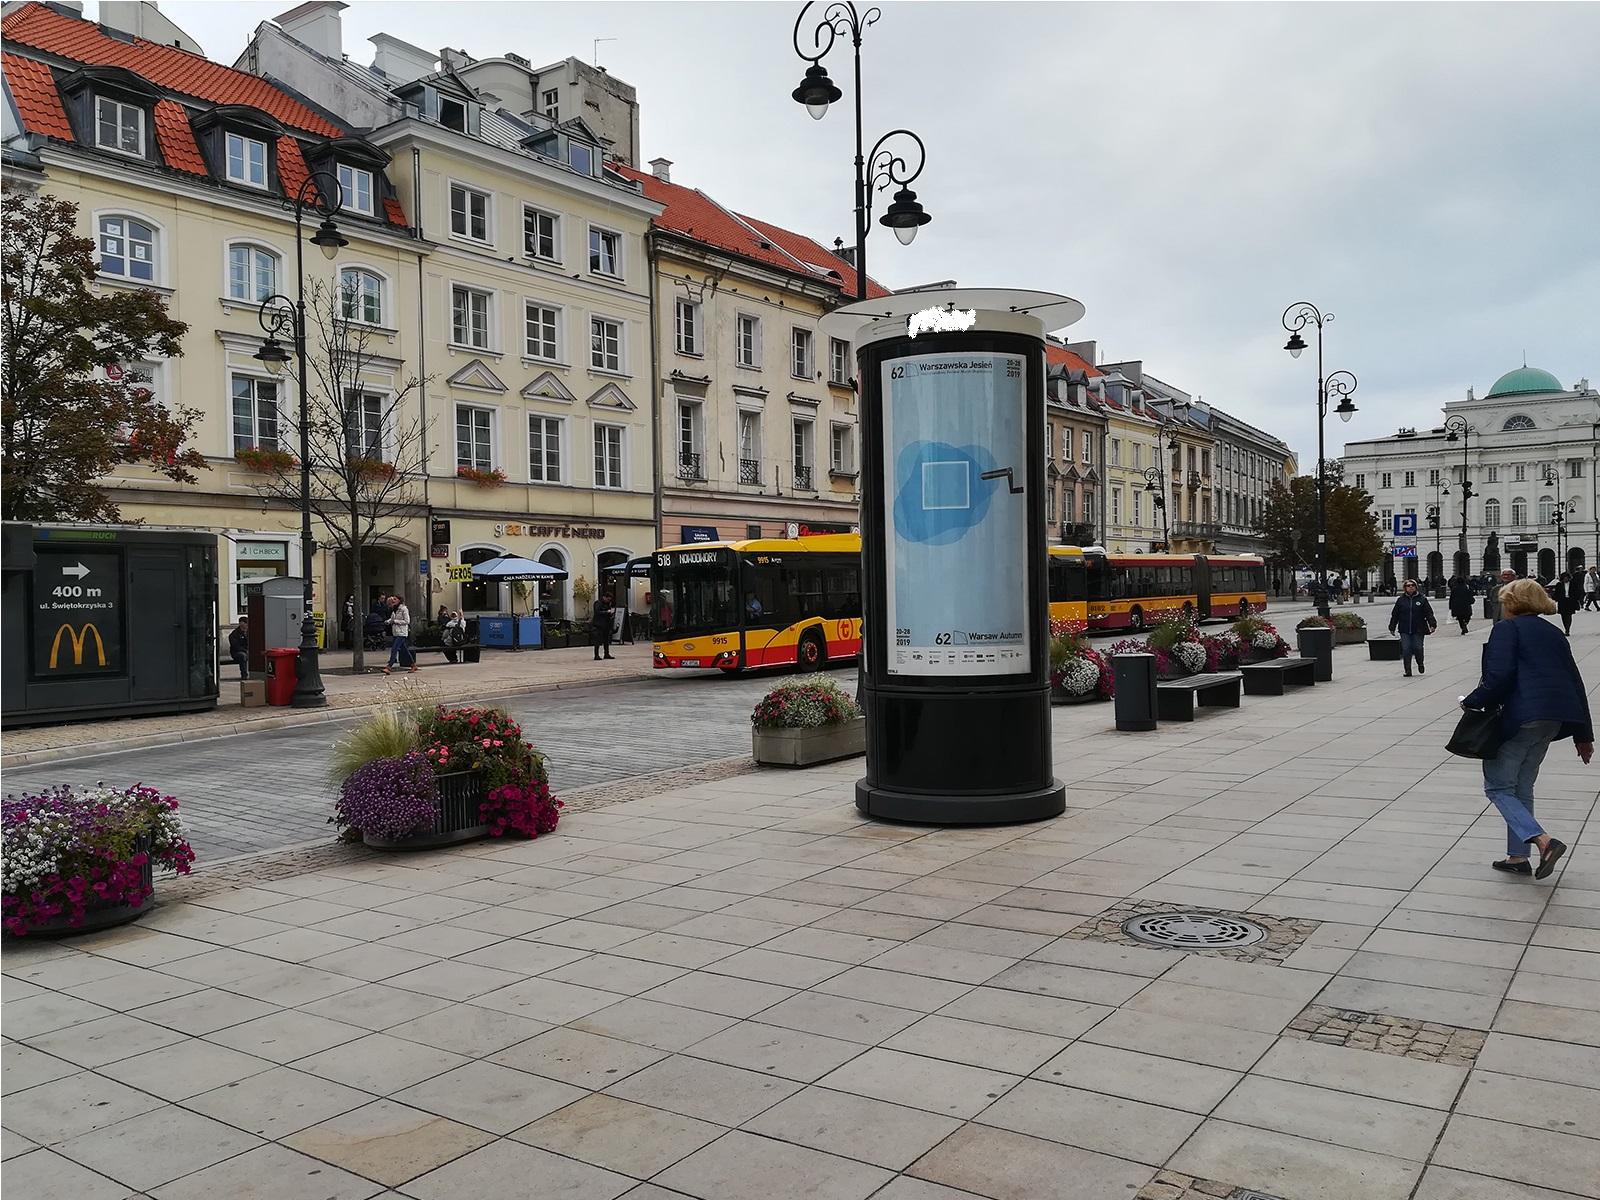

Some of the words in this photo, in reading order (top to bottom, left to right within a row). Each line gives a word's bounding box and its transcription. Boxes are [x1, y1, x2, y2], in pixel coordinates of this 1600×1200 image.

[890, 366, 905, 379] 62
[919, 361, 968, 371] Warszawska
[969, 360, 993, 370] Jesień
[1006, 369, 1021, 378] 2019
[1399, 516, 1412, 533] P
[91, 531, 118, 540] RUCH
[571, 527, 606, 540] NERO
[1395, 547, 1416, 556] TAXI
[657, 553, 671, 567] 518
[679, 551, 718, 564] NOWODWORY
[757, 556, 770, 564] 9915
[52, 586, 82, 597] 400
[86, 588, 102, 597] m
[52, 601, 106, 610] Świętokrzyska
[712, 637, 728, 645] 9915
[896, 638, 911, 646] 2019
[935, 632, 952, 645] 62
[968, 632, 998, 640] Warsaw
[999, 632, 1023, 640] Autumn
